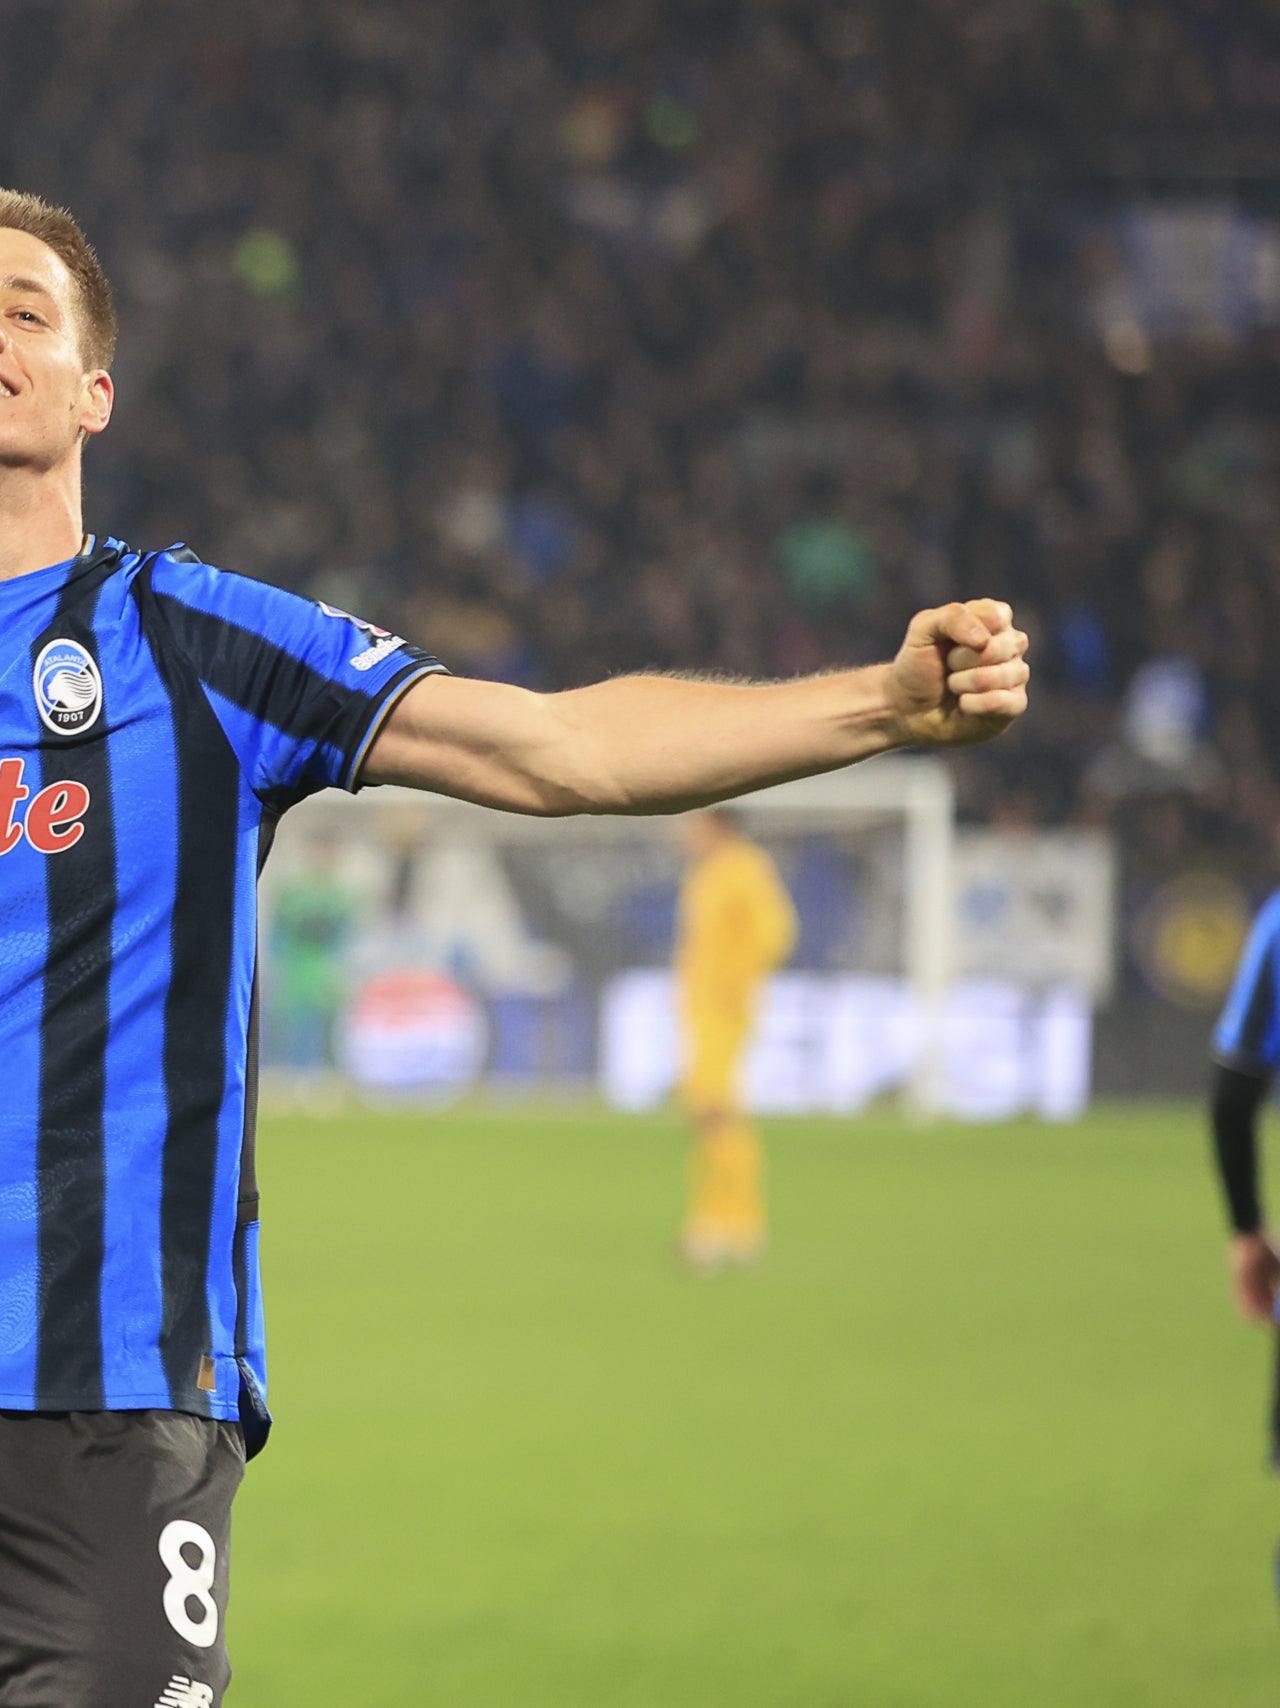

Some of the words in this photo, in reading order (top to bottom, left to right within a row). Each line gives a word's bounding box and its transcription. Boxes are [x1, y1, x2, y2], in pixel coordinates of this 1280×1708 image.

[43, 653, 88, 667] ATALANTA
[57, 711, 84, 723] 1907
[158, 1519, 218, 1648] 8
